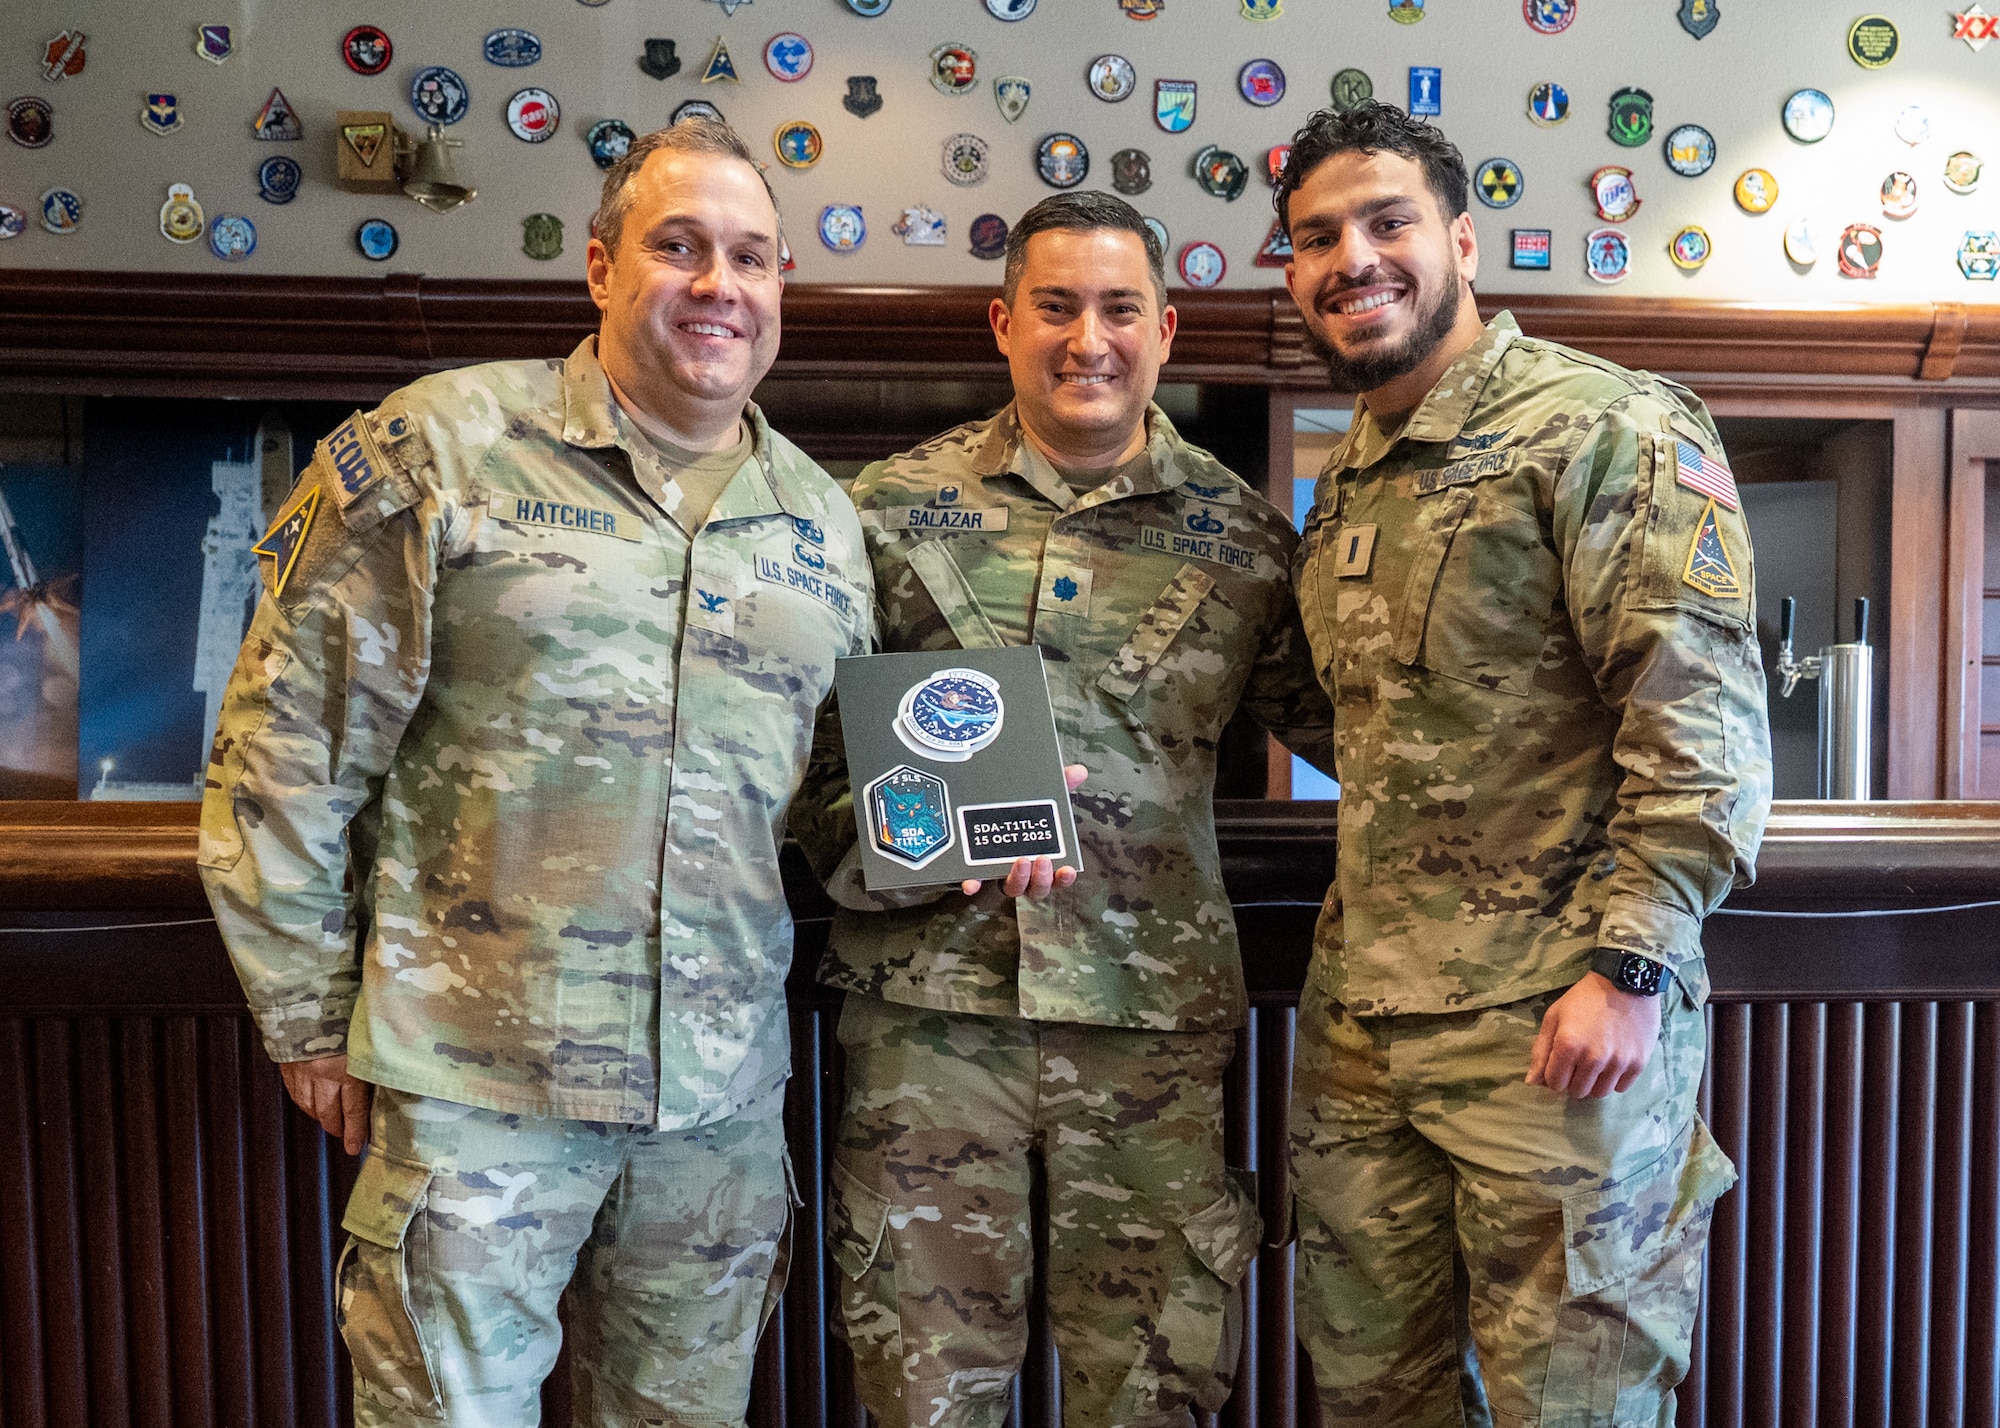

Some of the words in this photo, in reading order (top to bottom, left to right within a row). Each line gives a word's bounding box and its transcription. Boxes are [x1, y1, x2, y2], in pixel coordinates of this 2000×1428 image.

[520, 108, 548, 125] easy
[516, 499, 616, 534] HATCHER
[909, 509, 983, 529] SALAZAR
[1144, 529, 1167, 550] U.S.
[1172, 536, 1213, 559] SPACE
[1219, 543, 1255, 570] FORCE
[1700, 570, 1728, 585] SPACE
[760, 556, 785, 583] U.S.
[786, 567, 823, 599] SPACE
[824, 582, 853, 617] FORCE
[892, 775, 899, 785] 2
[901, 774, 922, 783] SLS
[901, 827, 926, 838] SDA
[973, 818, 1049, 834] SDA-T1TL-C
[974, 835, 990, 846] 15
[992, 833, 1019, 845] OCT
[1022, 830, 1053, 842] 2025
